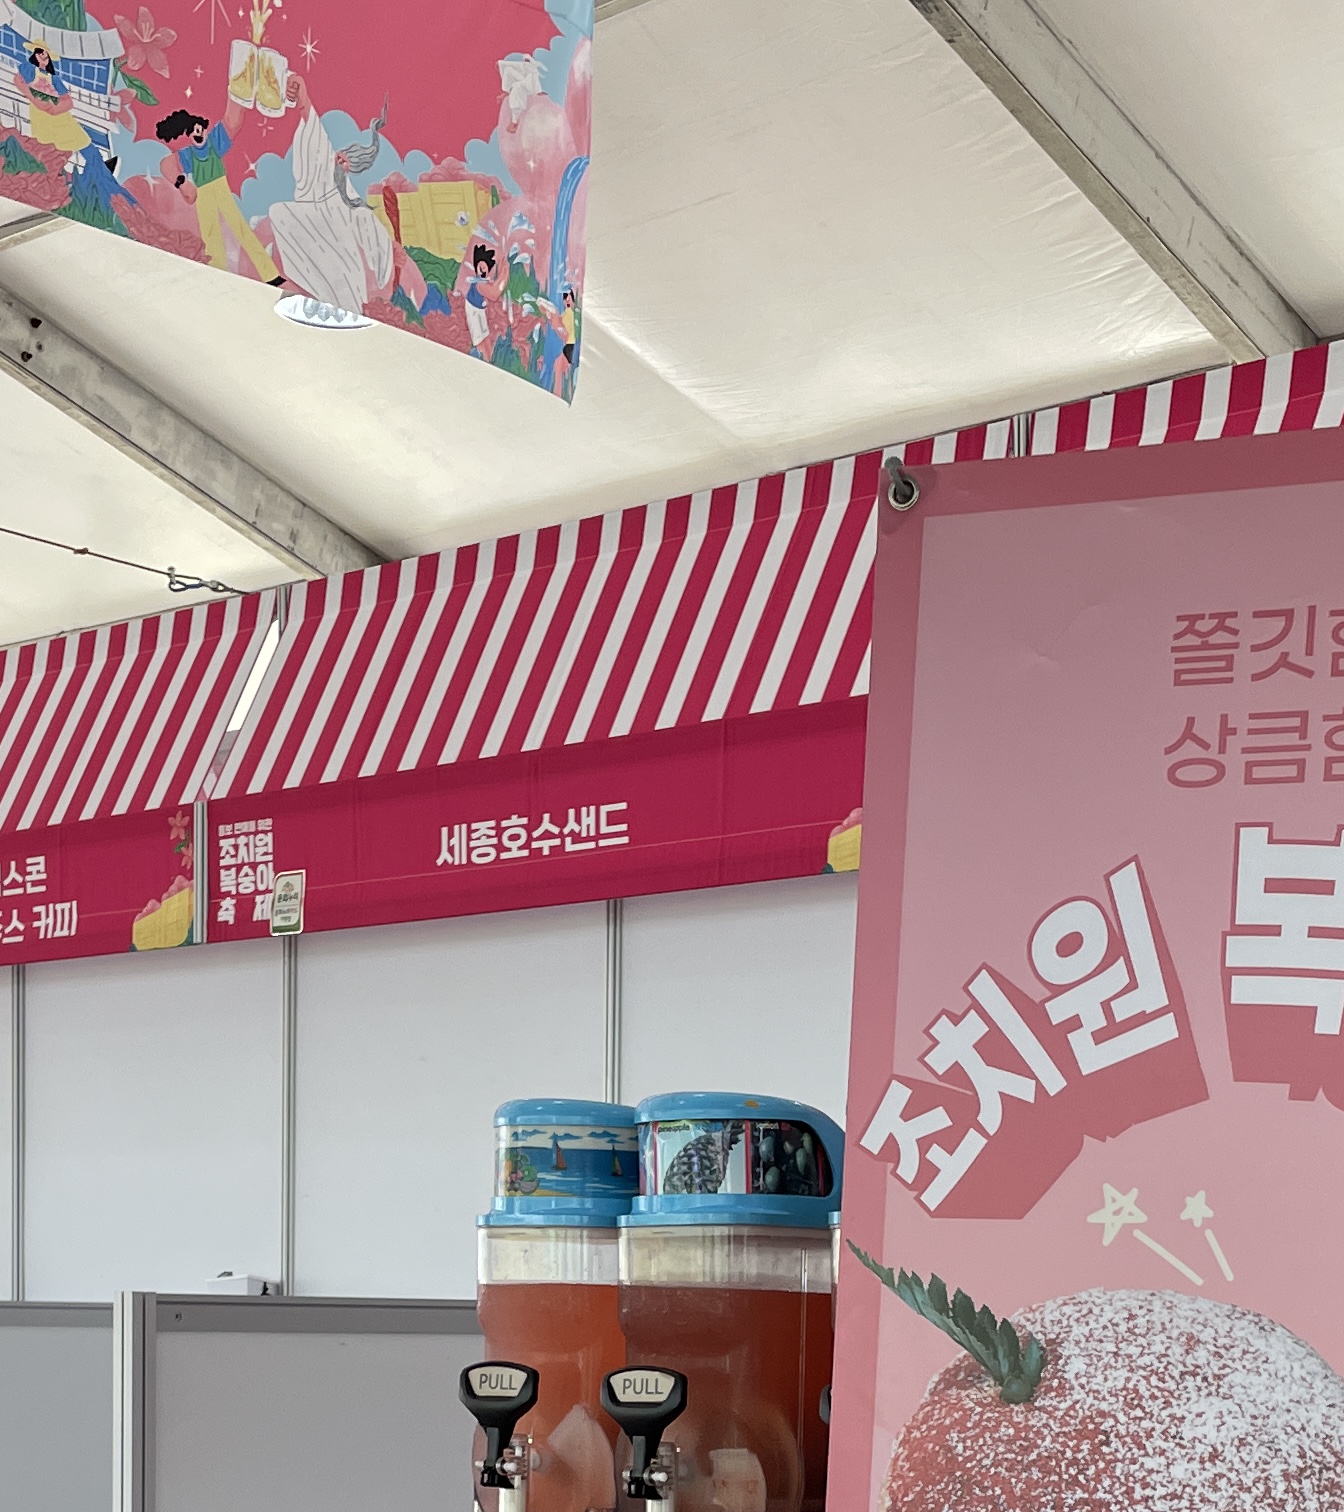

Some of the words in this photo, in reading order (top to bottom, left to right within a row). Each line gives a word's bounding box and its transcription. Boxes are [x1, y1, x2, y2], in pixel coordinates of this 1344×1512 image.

[219, 832, 273, 866] 조치원
[436, 802, 629, 866] 세종호수샌드
[220, 862, 275, 895] 복숭아
[32, 900, 77, 939] 커피
[859, 856, 1183, 1213] 조치원
[479, 1373, 518, 1392] PULL
[622, 1378, 664, 1396] PULL
